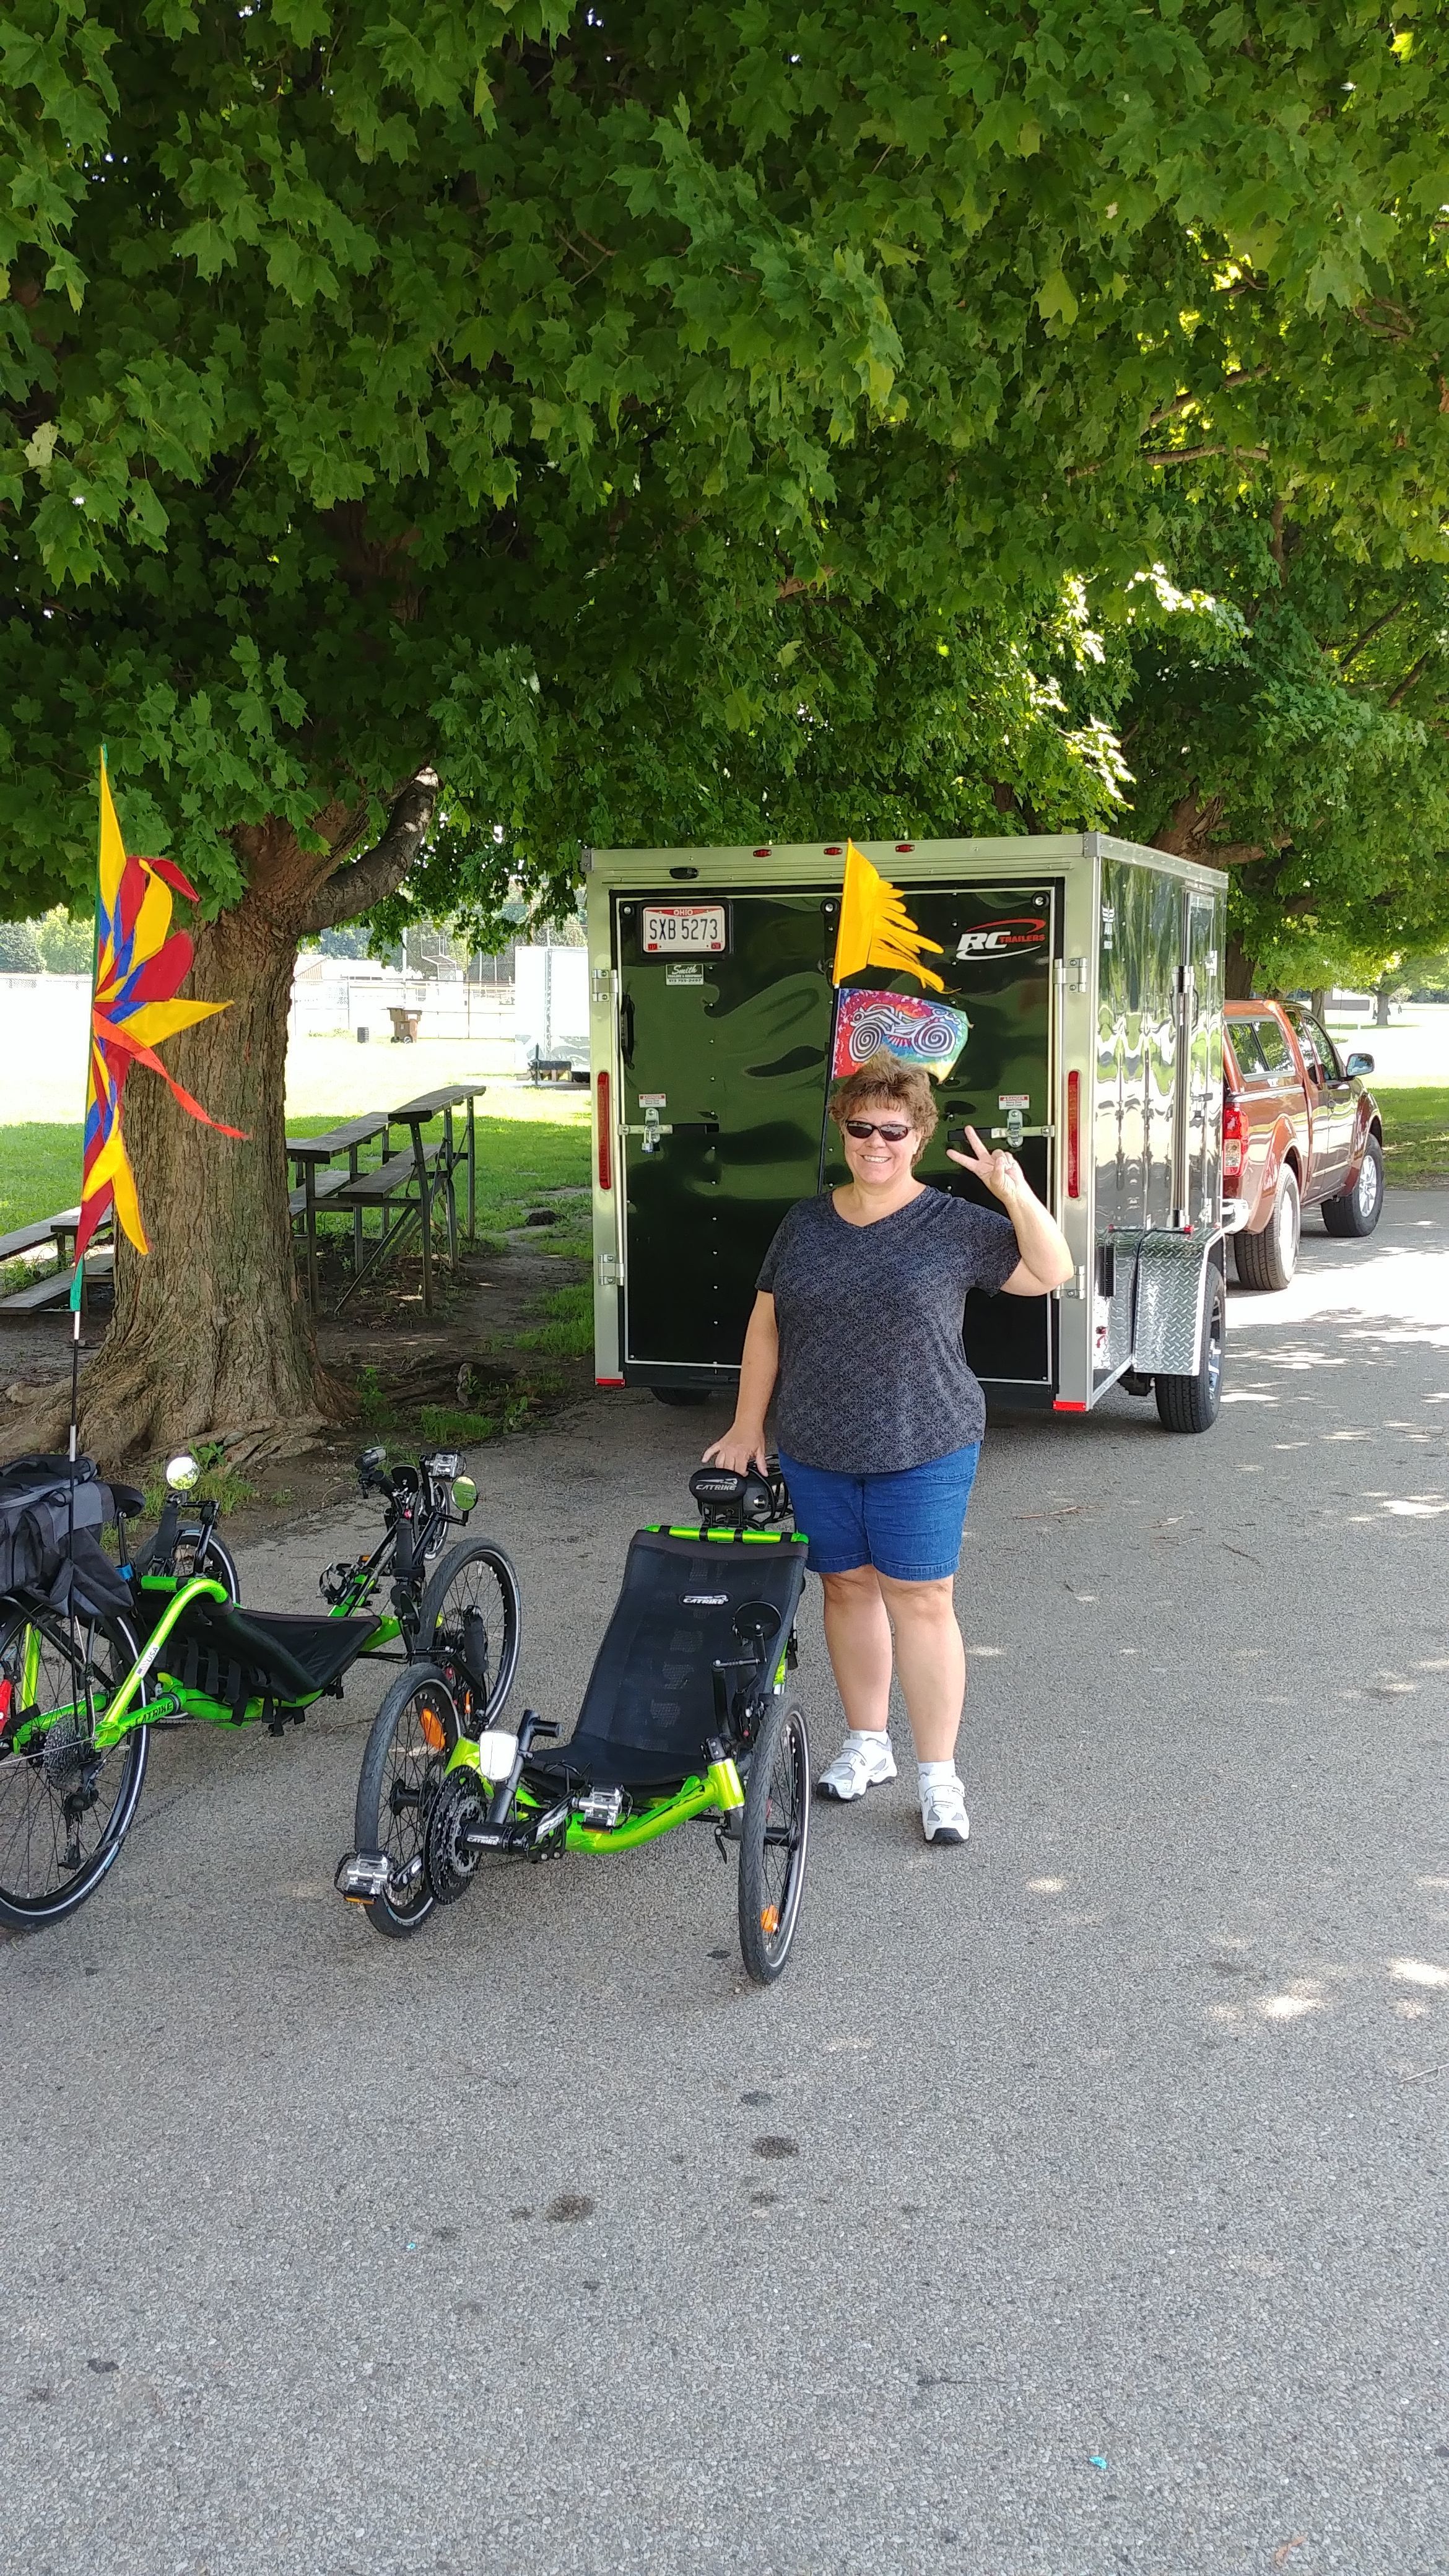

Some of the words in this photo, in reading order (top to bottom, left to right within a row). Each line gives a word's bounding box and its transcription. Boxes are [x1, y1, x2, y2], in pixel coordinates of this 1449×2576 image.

[650, 919, 676, 940] SXB
[681, 918, 718, 940] 5273
[956, 931, 1011, 951] RC
[999, 934, 1046, 944] TRAILERS
[671, 964, 698, 975] Smith
[146, 1647, 159, 1663] USA
[136, 1701, 173, 1725] CATRIKE
